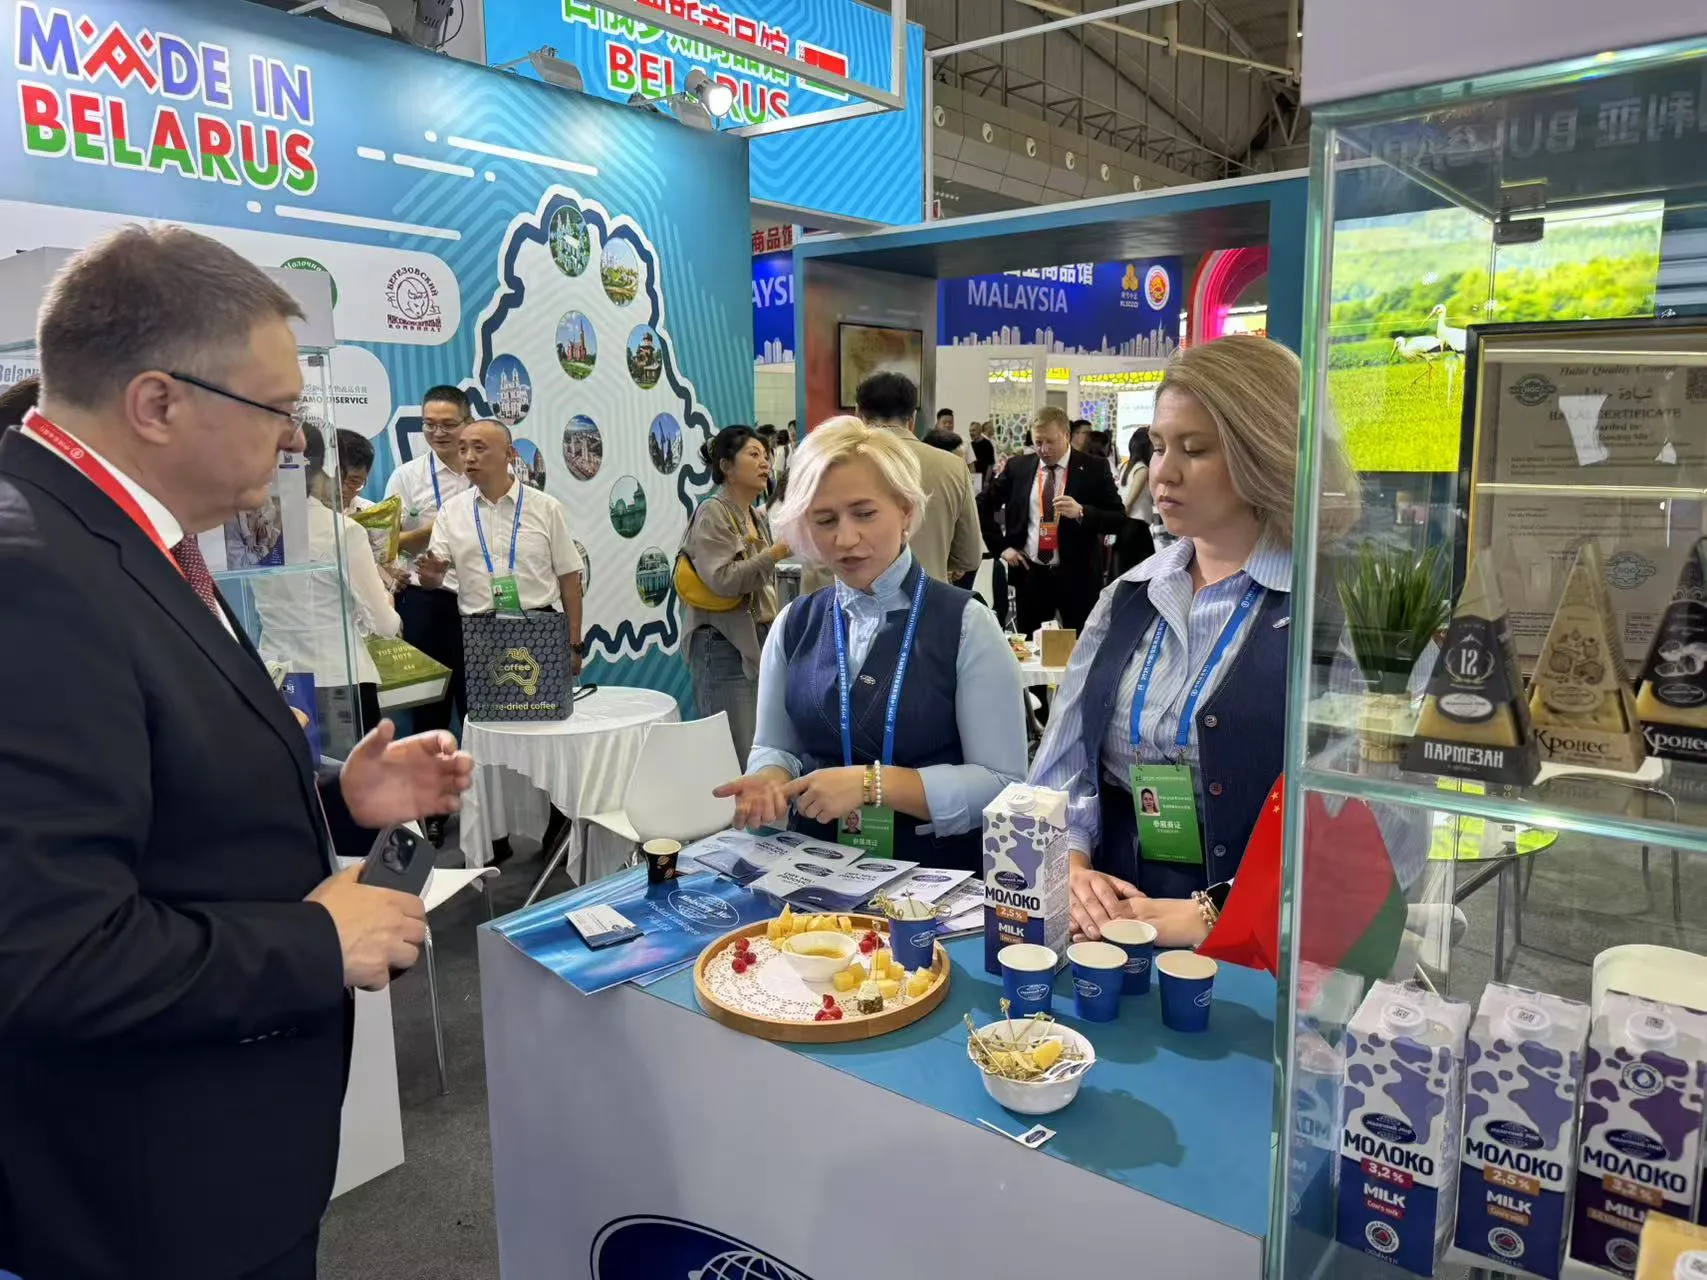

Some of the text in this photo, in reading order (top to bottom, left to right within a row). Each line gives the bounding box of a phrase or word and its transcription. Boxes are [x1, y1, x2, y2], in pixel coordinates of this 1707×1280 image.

[18, 6, 313, 124] MADE IN
[607, 41, 789, 124] BELRUS
[18, 82, 317, 195] BELARUS
[968, 279, 1068, 313] MALAYSIA
[499, 663, 531, 672] coffee
[1460, 649, 1479, 676] 12
[530, 701, 556, 710] coffee
[1424, 741, 1504, 769] ПАРМЕЗАН
[1533, 728, 1611, 759] Кронес
[985, 886, 1041, 911] МОЛОКО
[998, 922, 1025, 938] MILK
[1343, 1129, 1434, 1176] МОЛОКО
[1465, 1137, 1563, 1182] МОЛОКО
[1583, 1145, 1687, 1194] МОЛОКО
[1363, 1182, 1406, 1209] MILK
[1486, 1189, 1533, 1216] MILK
